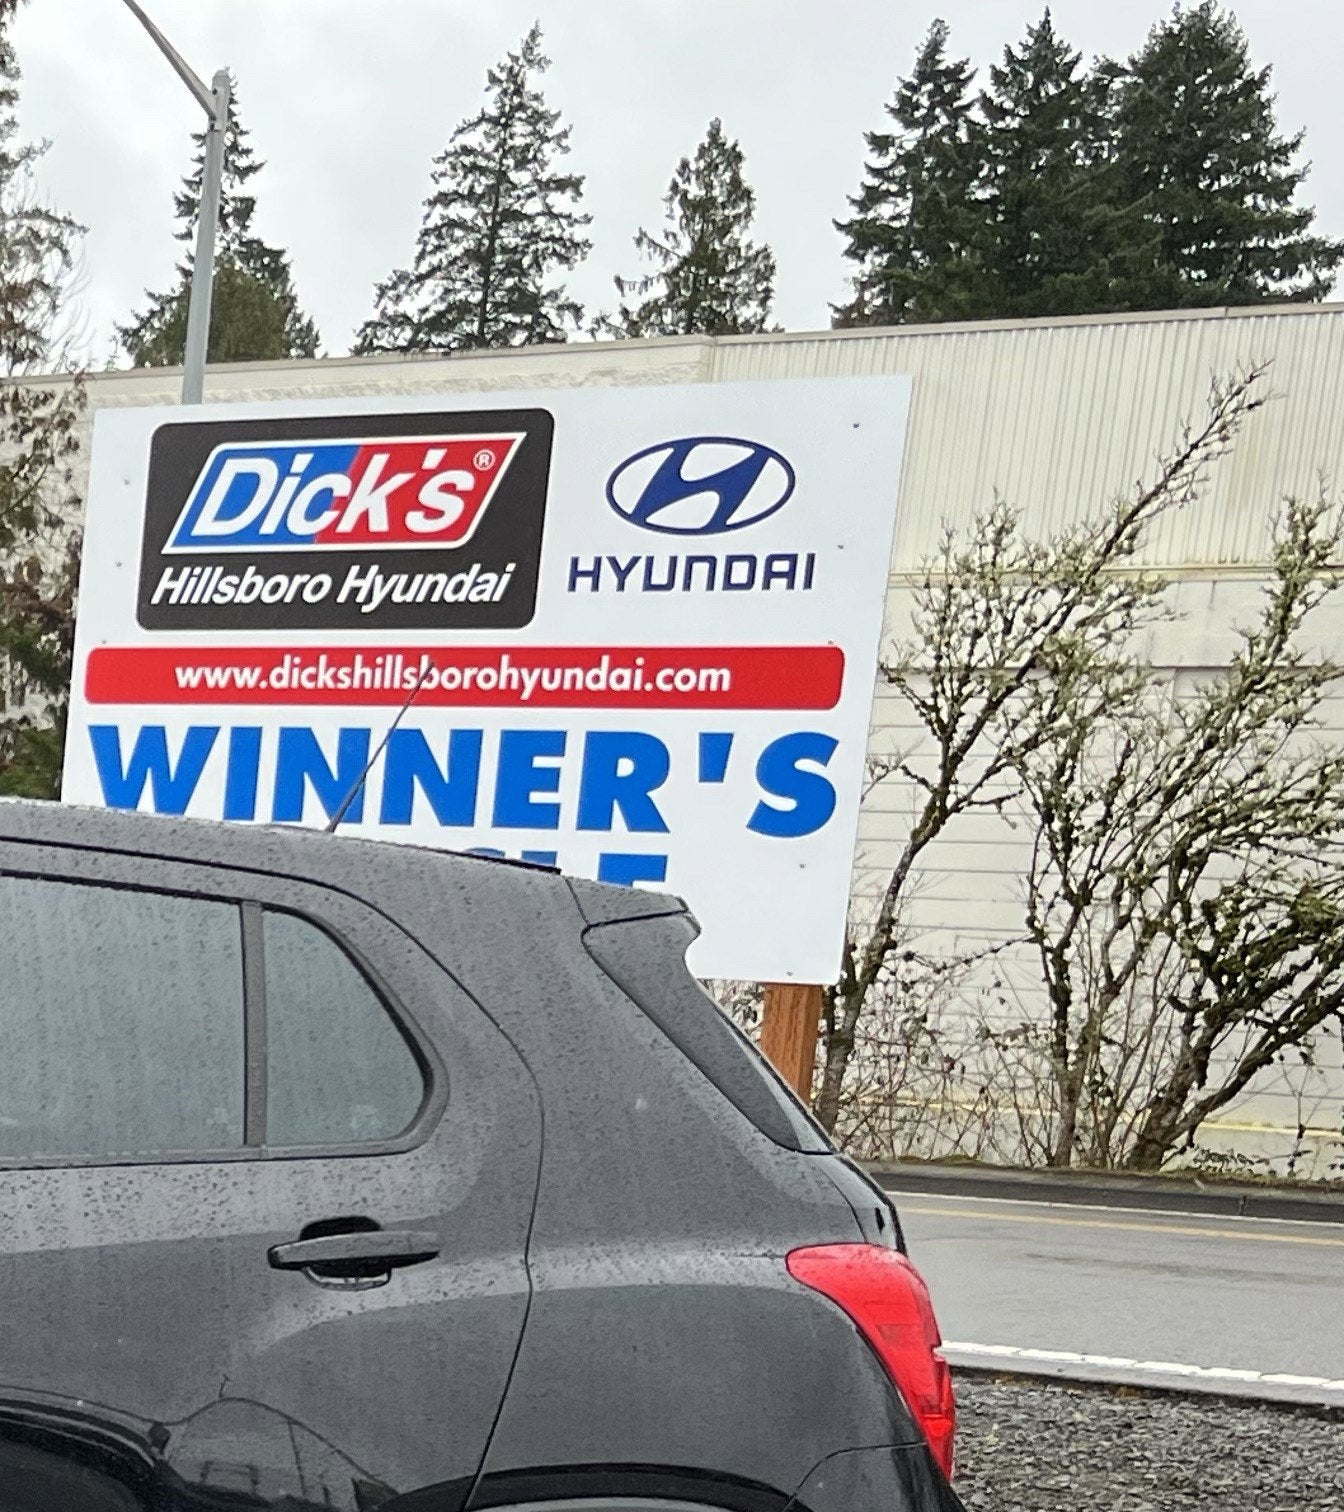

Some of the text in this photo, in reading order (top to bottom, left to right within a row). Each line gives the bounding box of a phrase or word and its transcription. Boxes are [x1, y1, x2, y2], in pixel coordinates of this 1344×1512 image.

[150, 562, 516, 613] Hillsboro Hyundai
[567, 552, 816, 592] HYUNDAI
[174, 654, 732, 700] www.dickshillsborohyundai.com
[88, 724, 839, 838] WINNER'S
